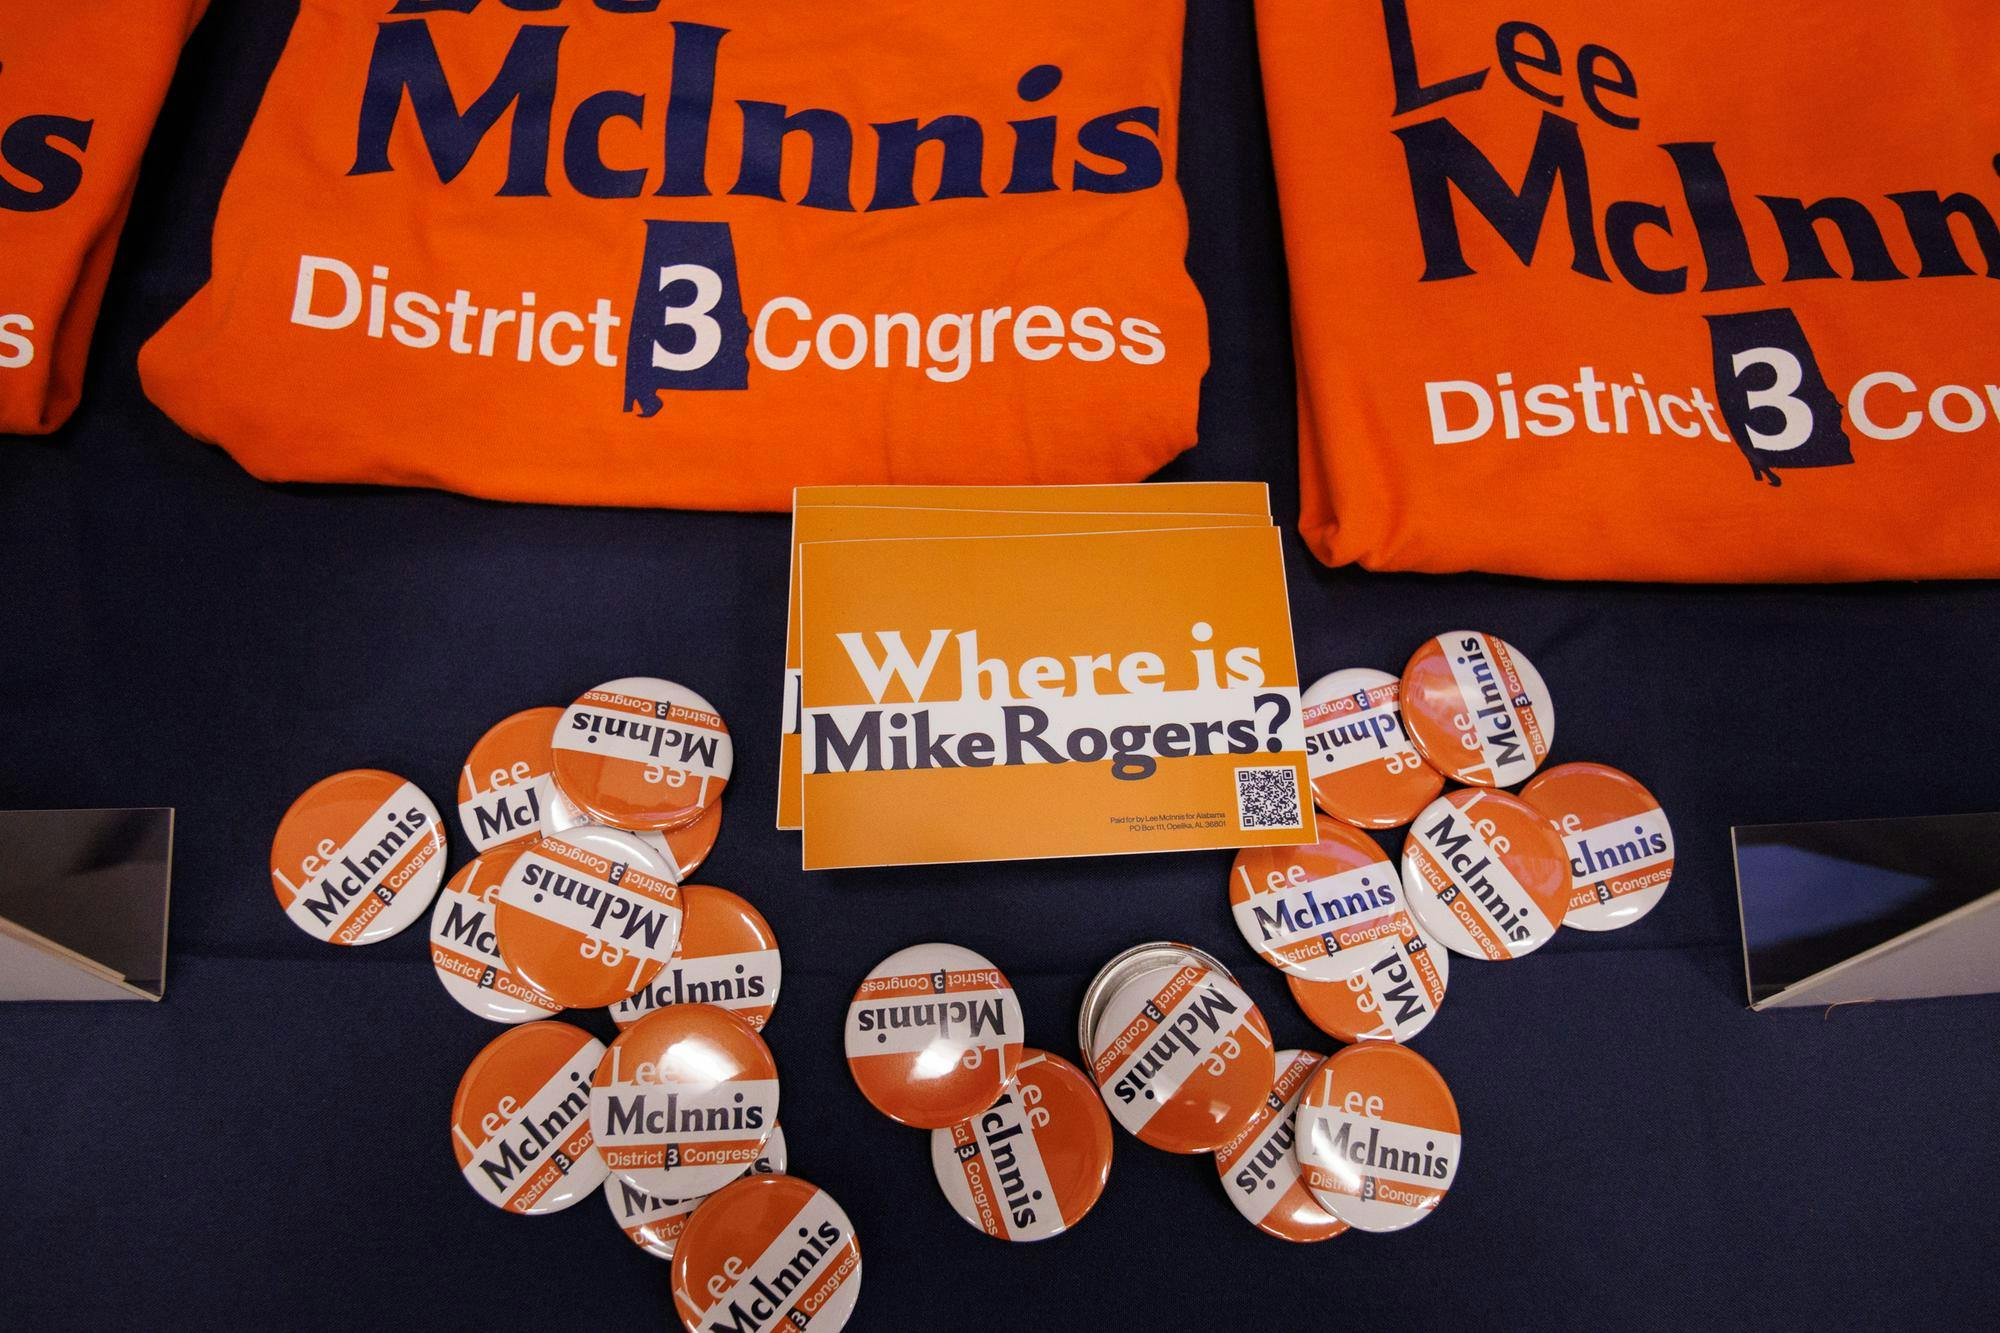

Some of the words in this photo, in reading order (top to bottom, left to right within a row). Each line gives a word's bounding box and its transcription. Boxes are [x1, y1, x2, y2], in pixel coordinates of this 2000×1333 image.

[1381, 0, 1640, 130] Lee
[345, 19, 1163, 213] McInnis
[1391, 110, 2000, 295] McInn
[290, 255, 621, 367] District
[652, 264, 722, 371] 3
[753, 296, 1166, 382] Congress
[1425, 367, 1731, 445] District
[1732, 346, 1814, 451] 3
[834, 628, 1166, 704] Where
[1189, 621, 1266, 691] is
[1491, 635, 1521, 693] Congress
[583, 692, 652, 713] Congress
[657, 703, 667, 716] 3
[1356, 693, 1368, 706] 3
[1368, 686, 1400, 701] strict
[1457, 636, 1526, 768] McInnis
[1515, 696, 1528, 706] 3
[572, 712, 719, 769] McInnis
[671, 708, 721, 727] District
[1521, 708, 1545, 755] District
[1383, 752, 1421, 774] ee
[1454, 714, 1488, 777] Lee
[464, 761, 534, 799] Lee
[643, 763, 711, 809] Lee
[1129, 824, 1141, 832] PO
[1136, 815, 1144, 823] by
[1158, 813, 1185, 822] McInnis
[1185, 812, 1195, 820] for
[1196, 811, 1226, 820] Alabama
[1457, 790, 1511, 857] Lee
[273, 838, 343, 897] Lee
[303, 806, 426, 928] McInnis
[542, 838, 609, 874] Congress
[611, 865, 624, 880] 3
[1572, 825, 1667, 878] cInnis
[339, 899, 383, 944] District
[377, 886, 393, 902] 3
[389, 833, 446, 888] Congress
[462, 861, 500, 904] Le
[624, 869, 677, 900] District
[1237, 864, 1310, 900] Lee
[1425, 814, 1532, 942] McInnis
[1568, 891, 1597, 911] trict
[1597, 885, 1609, 899] 3
[1612, 869, 1672, 894] Congress
[521, 863, 669, 950] McInnis
[1253, 877, 1396, 941] McInnis
[1405, 846, 1447, 891] District
[1442, 890, 1457, 903] 3
[1453, 901, 1501, 960] Congress
[579, 934, 651, 993] Lee
[1272, 941, 1323, 966] District
[1325, 937, 1337, 951] 3
[1340, 919, 1403, 946] Congress
[1408, 941, 1422, 951] 3
[433, 951, 480, 980] District
[482, 970, 493, 986] 3
[619, 965, 765, 1013] McInnis
[861, 976, 929, 992] Congress
[934, 974, 944, 989] 3
[948, 971, 999, 987] District
[1156, 967, 1198, 1009] District
[1416, 954, 1445, 1003] District
[858, 998, 1006, 1044] McInnis
[1146, 1007, 1161, 1020] 3
[611, 1046, 681, 1087] Lee
[962, 1043, 1007, 1084] Le
[1097, 1018, 1150, 1073] Congress
[1114, 983, 1238, 1104] McInnis
[1199, 1019, 1272, 1077] Lee
[1276, 1051, 1315, 1097] District
[1321, 1068, 1384, 1120] Lee
[452, 1095, 522, 1157] Lee
[606, 1093, 763, 1136] McInnis
[608, 1152, 663, 1166] District
[667, 1149, 679, 1164] 3
[684, 1148, 758, 1163] Congress
[1235, 1107, 1296, 1195] nnis
[1312, 1117, 1448, 1180] McInnis
[514, 1165, 559, 1212] District
[555, 1155, 569, 1168] 3
[959, 1145, 975, 1157] 3
[967, 1161, 998, 1236] Congress
[1364, 1182, 1374, 1197] 3
[633, 1221, 685, 1245] Dtrict
[676, 1255, 750, 1317] Lee
[709, 1221, 841, 1333] McInnis
[792, 1311, 807, 1326] 3
[804, 1251, 860, 1312] Congress
